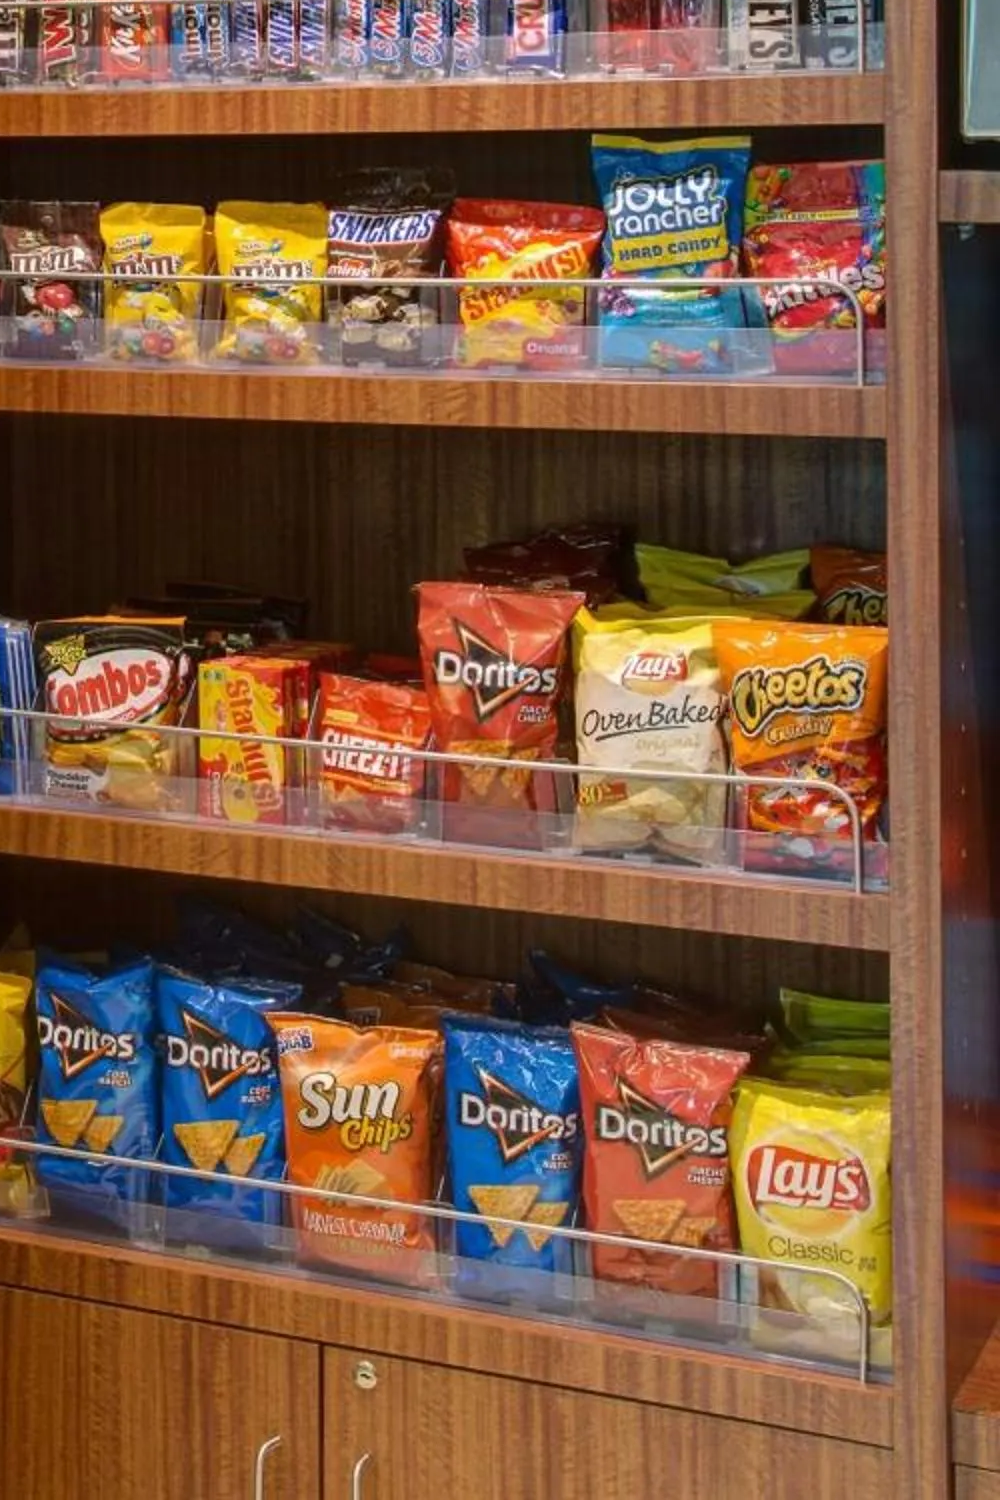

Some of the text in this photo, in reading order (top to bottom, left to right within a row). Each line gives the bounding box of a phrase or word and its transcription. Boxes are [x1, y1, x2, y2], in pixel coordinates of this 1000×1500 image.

[609, 169, 716, 217] JOLLY
[327, 211, 438, 243] SNICKERS
[614, 203, 722, 237] rancher
[618, 245, 664, 262] HARD
[437, 650, 558, 693] Doritos
[733, 658, 863, 733] Cheetos
[582, 708, 643, 737] Oven
[37, 1017, 135, 1059] Doritos
[168, 1036, 272, 1076] Doritos
[298, 1071, 400, 1129] Sun
[460, 1092, 578, 1140] Doritos
[340, 1113, 413, 1153] Chips
[599, 1108, 728, 1155] Doritos
[755, 1147, 862, 1209] Lay's
[767, 1235, 854, 1265] Classic
